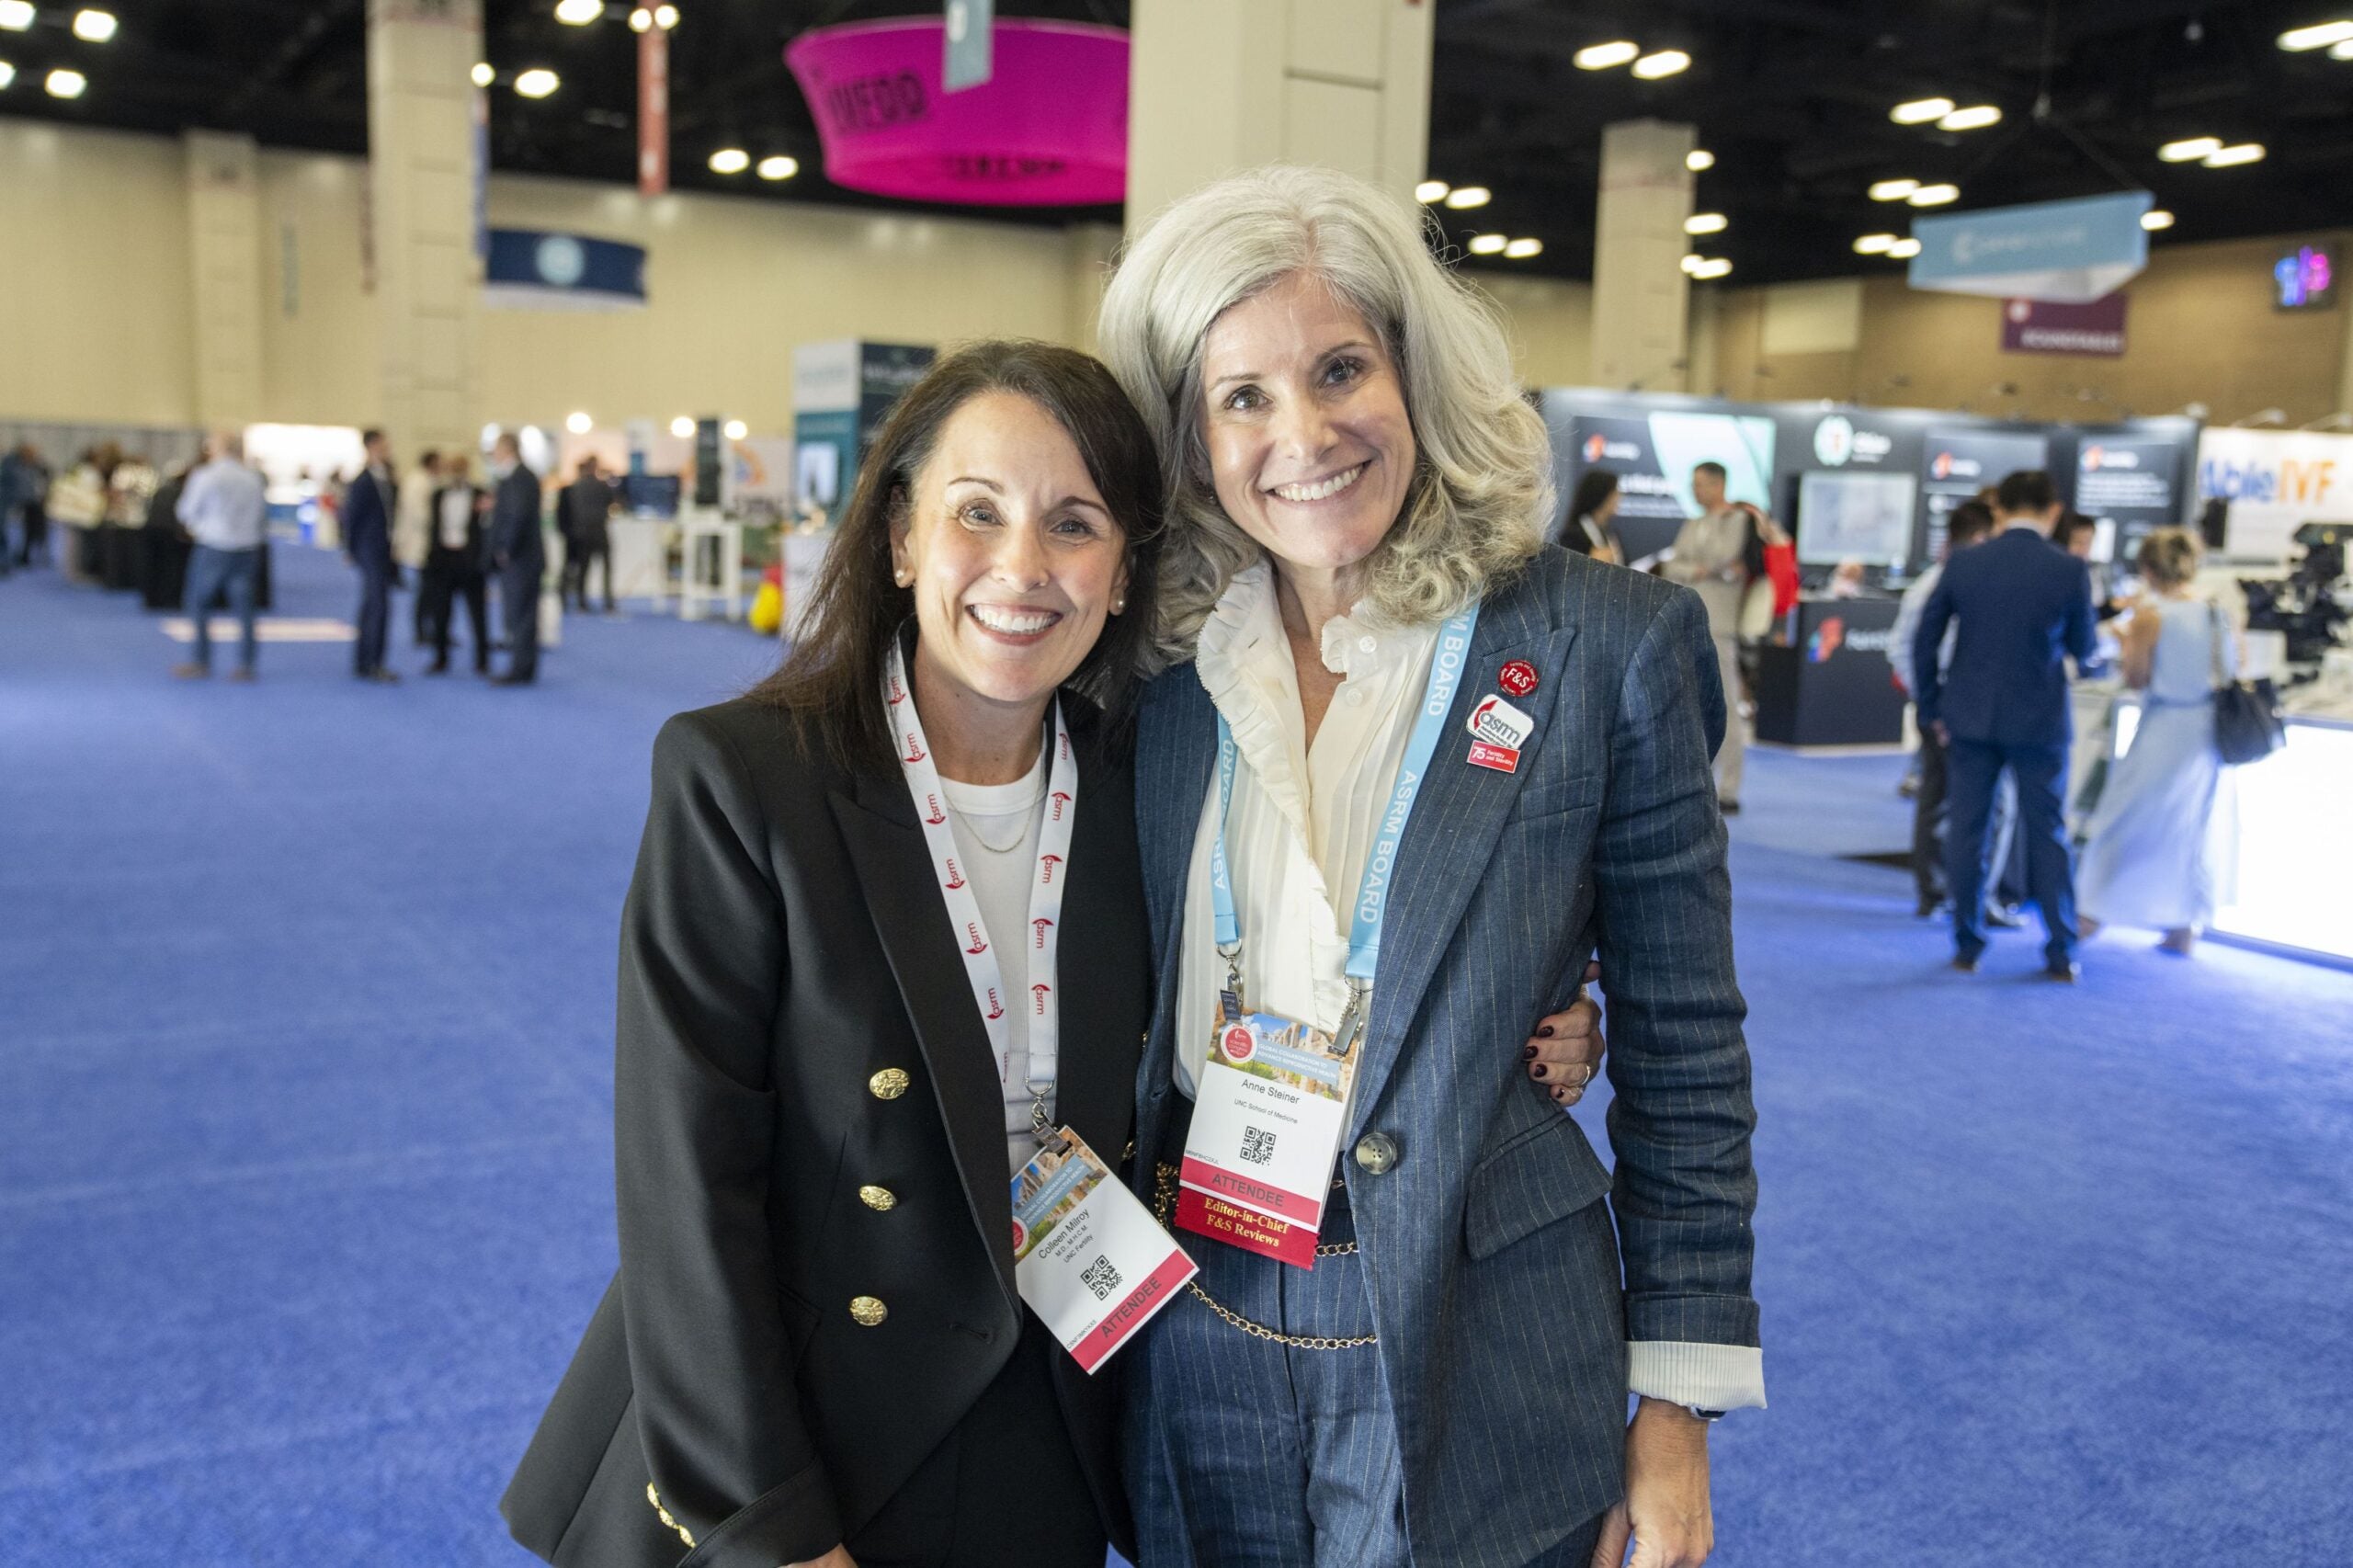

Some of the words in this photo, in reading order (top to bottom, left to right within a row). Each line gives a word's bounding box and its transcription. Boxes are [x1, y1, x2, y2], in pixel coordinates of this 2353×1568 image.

[1428, 636, 1463, 716] BOARD
[1506, 668, 1529, 687] F&S
[907, 733, 920, 758] asrm
[1472, 746, 1486, 760] 75
[1222, 739, 1234, 811] OARD
[927, 794, 941, 821] asrm
[1052, 796, 1063, 821] asrm
[1384, 770, 1417, 835] ASRM
[946, 859, 961, 885] asrm
[1042, 858, 1053, 883] asrm
[1213, 836, 1226, 890] ASR
[1360, 840, 1393, 924] BOARD
[968, 922, 983, 949] asrm
[1036, 922, 1045, 949] asrm
[987, 987, 1000, 1015] asrm
[1036, 988, 1044, 1015] asrm
[1242, 1079, 1265, 1093] Anne
[1268, 1087, 1300, 1104] Steiner
[1234, 1098, 1247, 1108] UNC
[1248, 1103, 1267, 1113] School
[1274, 1111, 1298, 1123] Medicine
[1212, 1174, 1284, 1206] ATTENDEE
[1204, 1198, 1290, 1234] Editor-in-Chief
[1039, 1231, 1067, 1259] Colleen
[1065, 1209, 1089, 1233] Milroy
[1207, 1213, 1232, 1231] F&S
[1234, 1223, 1279, 1247] Reviews
[1063, 1250, 1076, 1264] UNC
[1075, 1234, 1094, 1251] Fertility
[1101, 1277, 1162, 1338] ATTENDEE
